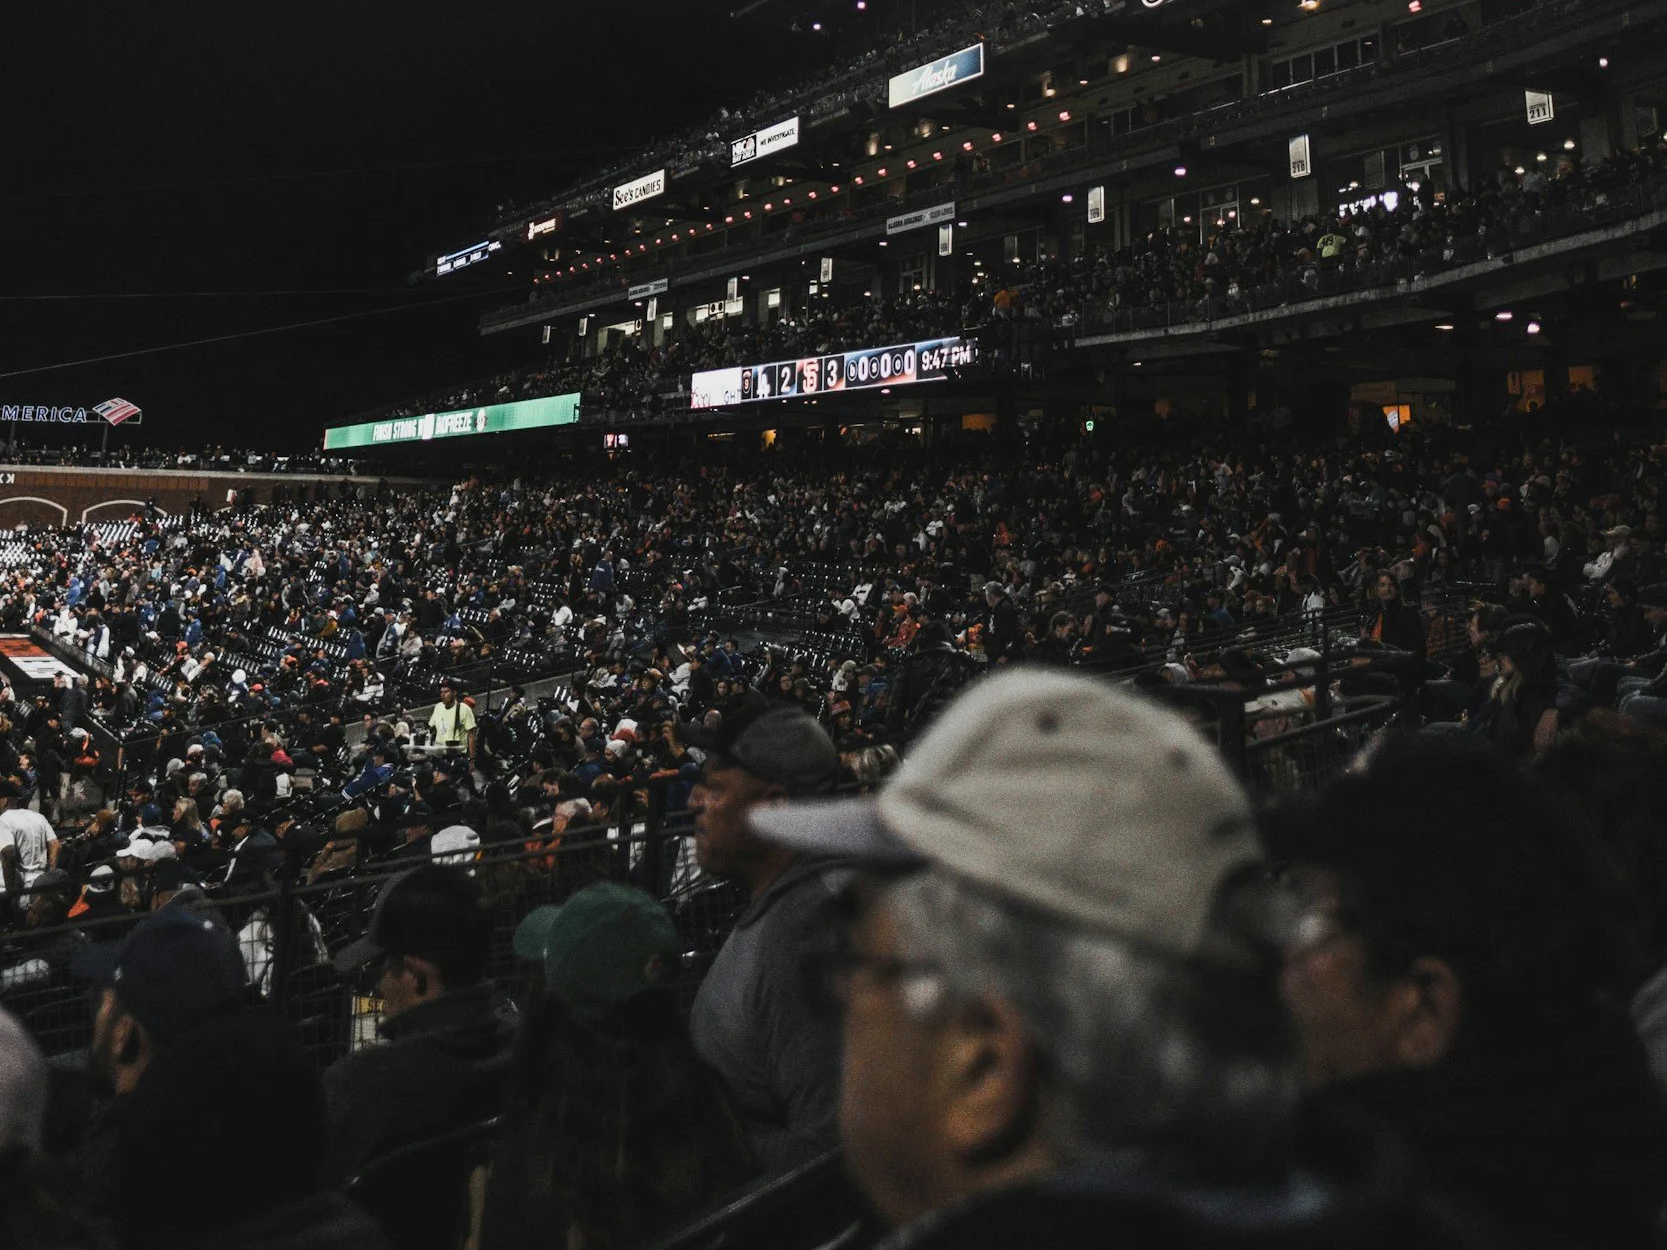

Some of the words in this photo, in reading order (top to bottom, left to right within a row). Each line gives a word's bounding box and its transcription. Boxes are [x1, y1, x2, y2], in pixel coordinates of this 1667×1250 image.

[912, 59, 957, 94] Alaska
[1529, 106, 1547, 119] 211
[767, 128, 795, 144] INVESTIGATE
[1292, 163, 1305, 174] 210
[615, 188, 634, 206] See's
[635, 179, 661, 199] CANDIES
[781, 366, 792, 393] 2
[826, 359, 838, 387] 3
[858, 356, 869, 381] 0
[880, 352, 892, 378] 0
[903, 349, 915, 375] 0
[922, 348, 948, 371] 9:47
[951, 345, 971, 367] PM
[1, 405, 87, 423] MERICA
